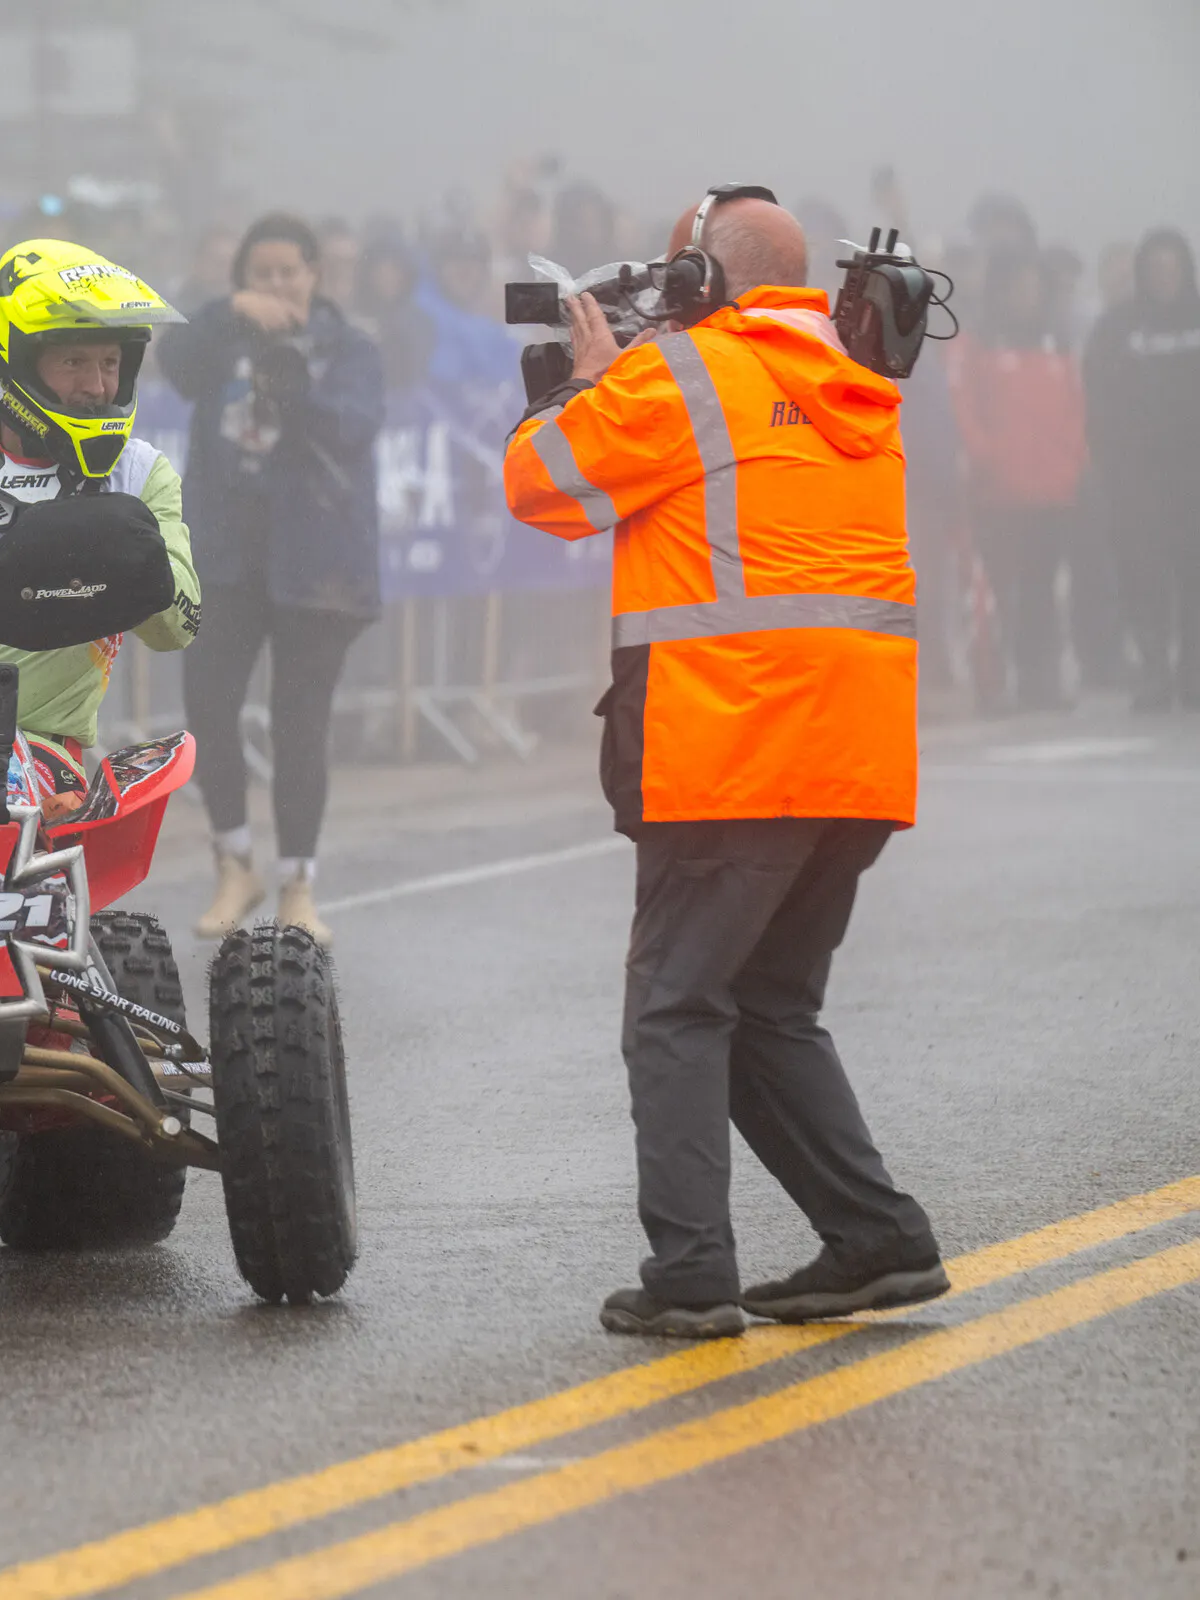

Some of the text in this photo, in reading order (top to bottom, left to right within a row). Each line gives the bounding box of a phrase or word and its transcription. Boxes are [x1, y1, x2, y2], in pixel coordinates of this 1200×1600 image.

[3, 391, 49, 439] POWER
[101, 422, 126, 431] LEATT
[1, 474, 57, 489] LEATT
[50, 968, 90, 992] LONE
[90, 985, 132, 1011] STAR
[130, 1001, 182, 1035] RACING
